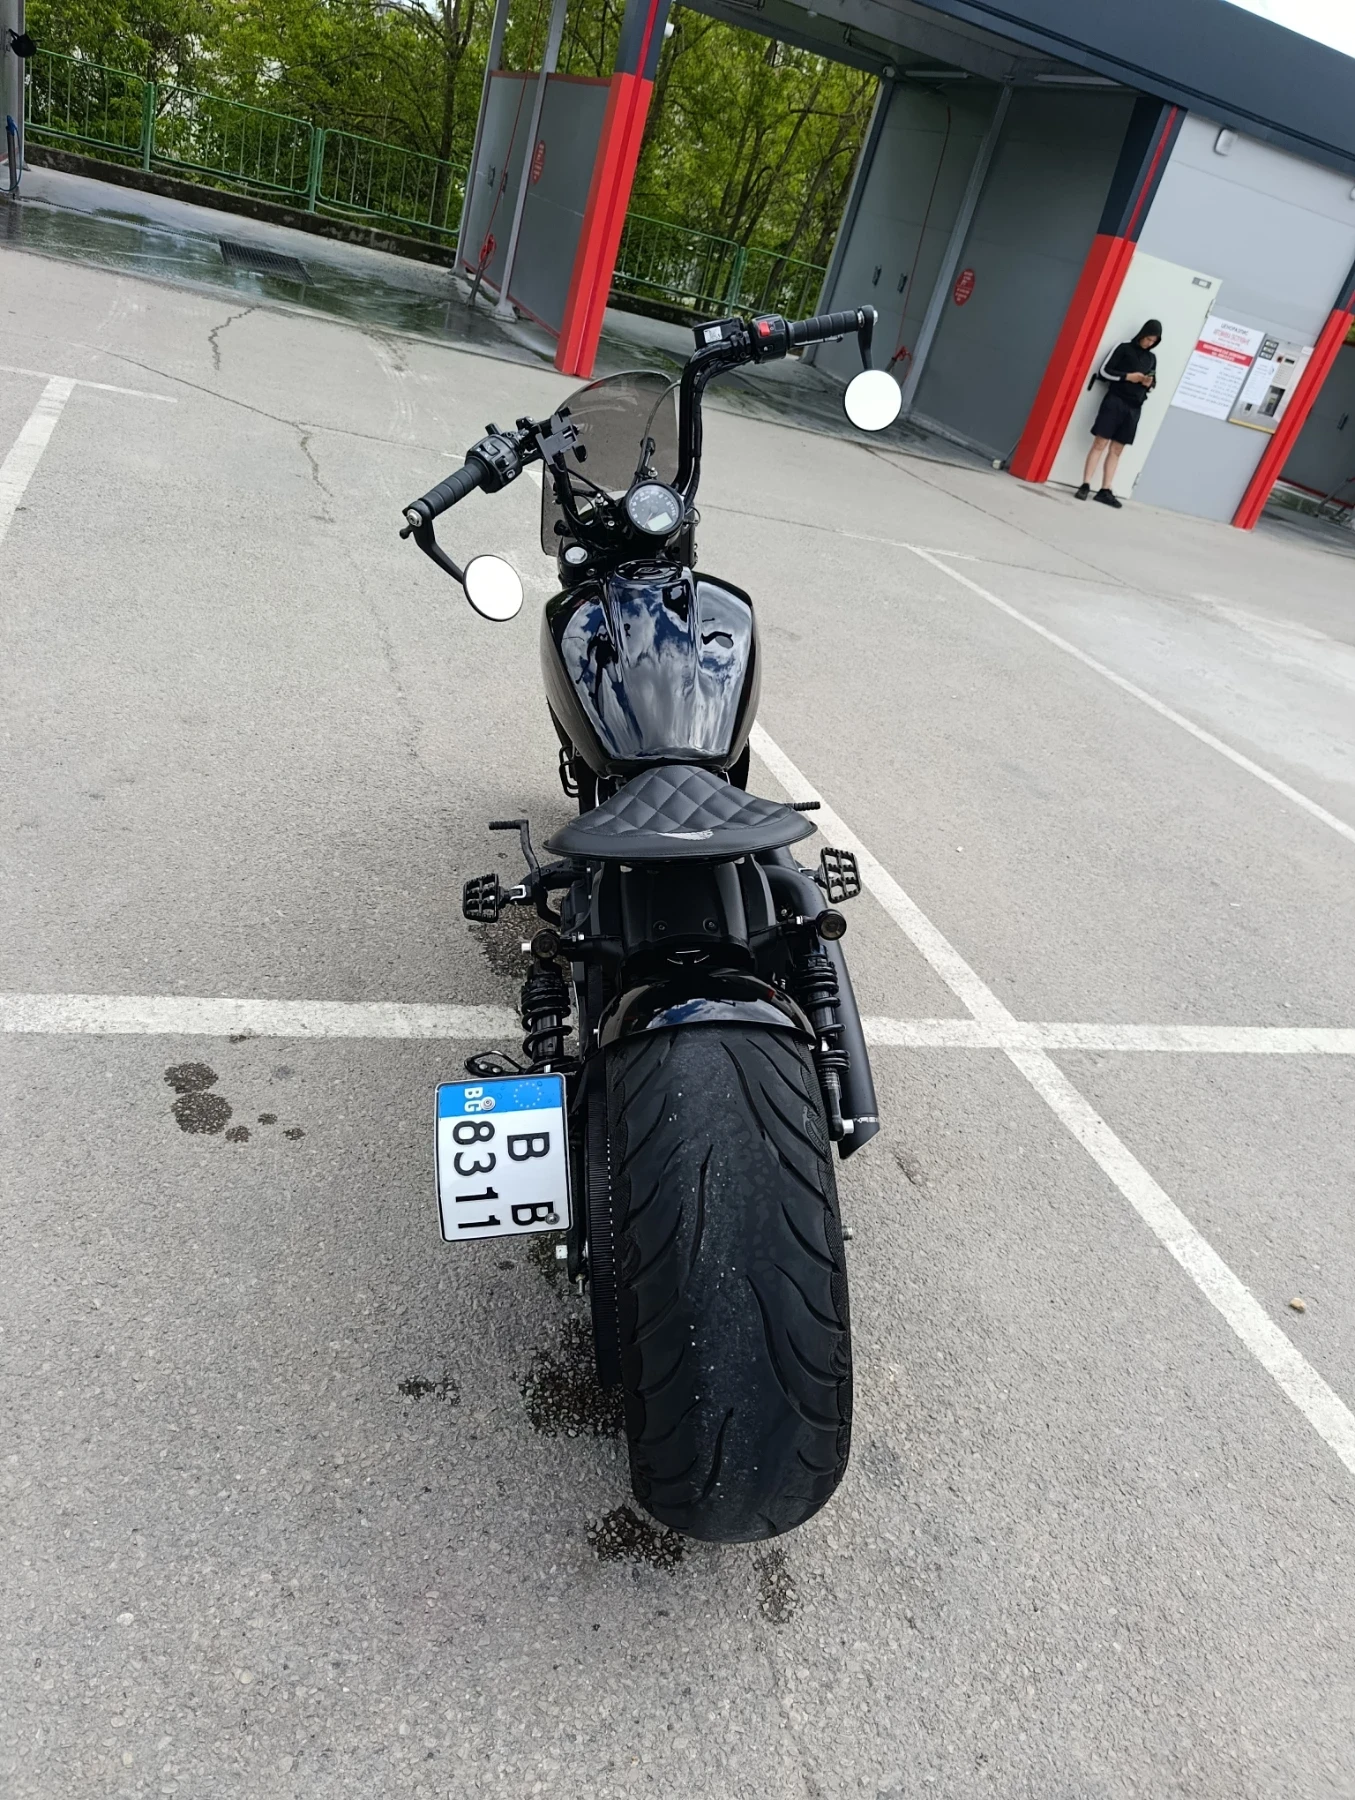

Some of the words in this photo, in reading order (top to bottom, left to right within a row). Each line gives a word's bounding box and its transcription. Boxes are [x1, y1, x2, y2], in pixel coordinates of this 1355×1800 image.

[464, 1086, 484, 1112] BG
[507, 1132, 551, 1161] B
[452, 1120, 502, 1229] 8311
[511, 1201, 555, 1226] B
